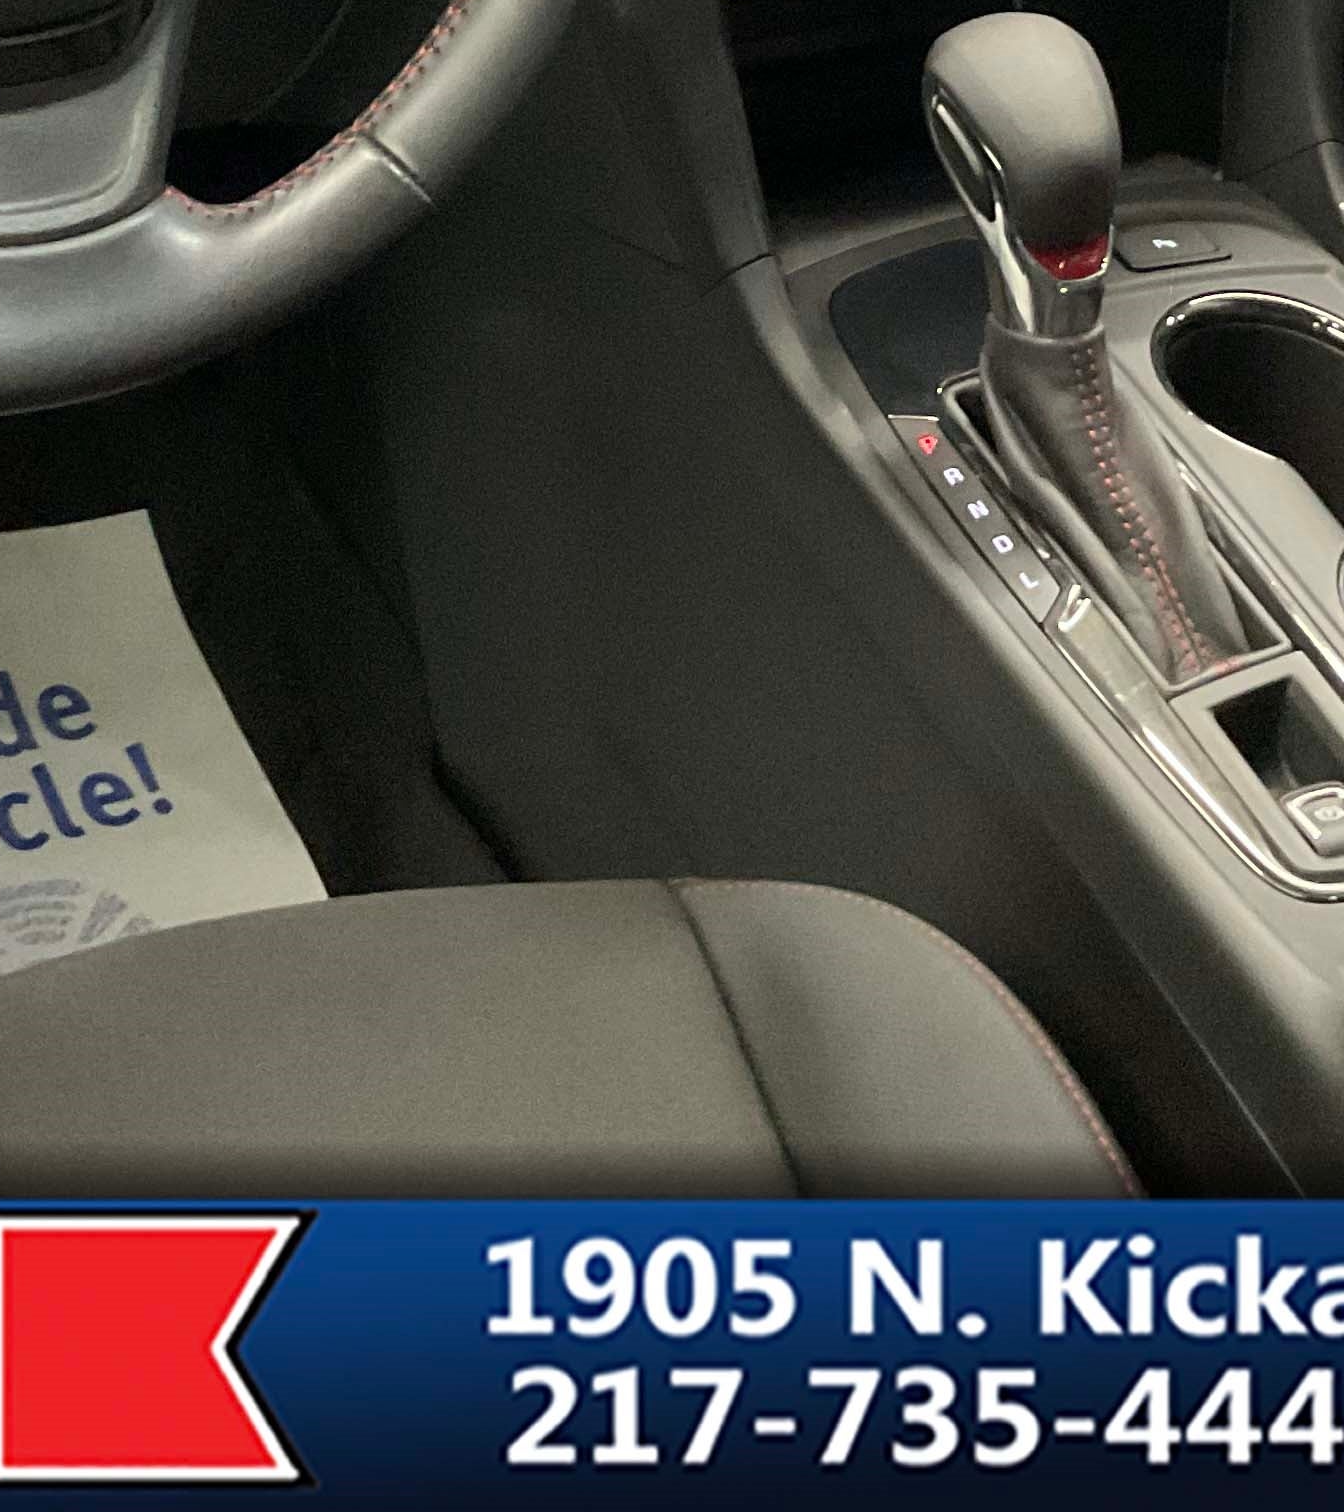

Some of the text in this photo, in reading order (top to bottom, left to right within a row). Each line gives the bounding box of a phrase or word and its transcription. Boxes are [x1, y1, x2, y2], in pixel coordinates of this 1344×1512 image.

[943, 467, 965, 486] R
[967, 499, 989, 519] N
[991, 534, 1014, 554] D
[1019, 572, 1039, 590] L
